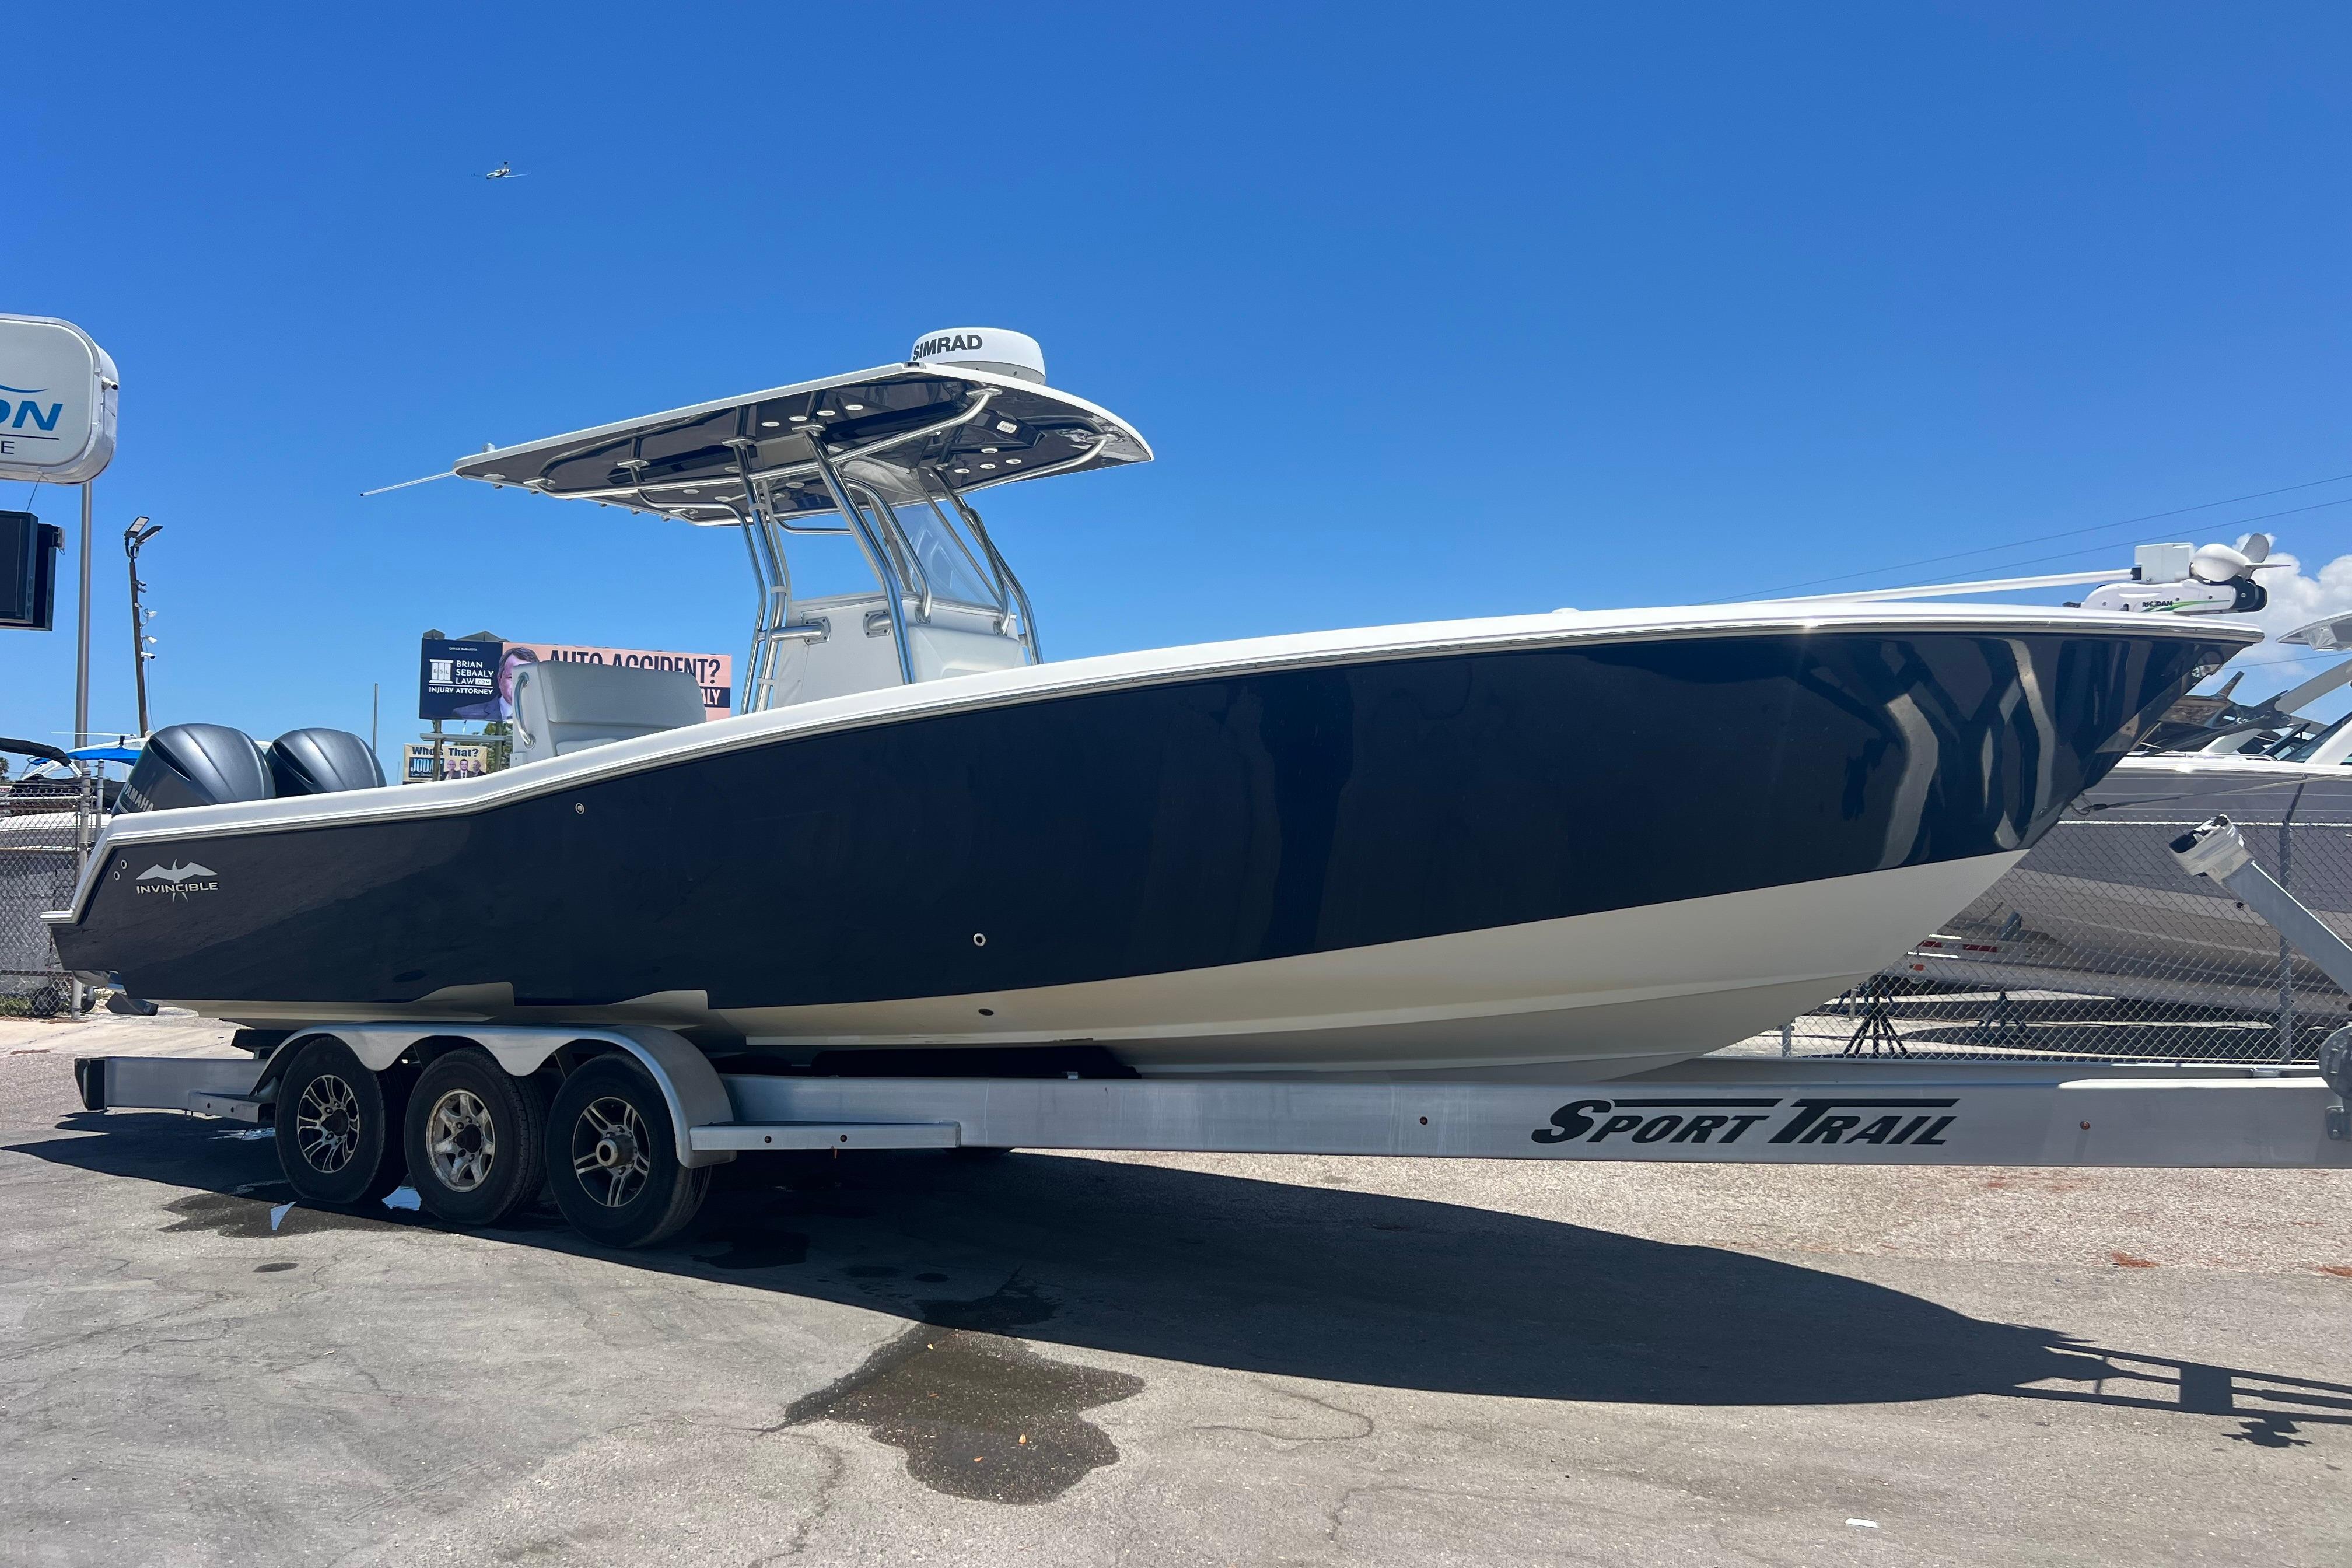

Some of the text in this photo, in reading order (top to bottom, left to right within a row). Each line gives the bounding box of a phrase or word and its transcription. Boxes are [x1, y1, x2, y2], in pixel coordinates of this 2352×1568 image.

[912, 334, 983, 361] SIMRAD
[456, 660, 483, 668] BRIAN
[456, 668, 494, 678] SEBAALY
[448, 748, 479, 757] That?
[136, 882, 219, 894] INVINCIBLE
[1531, 1098, 1961, 1146] SPORT TRAIL
